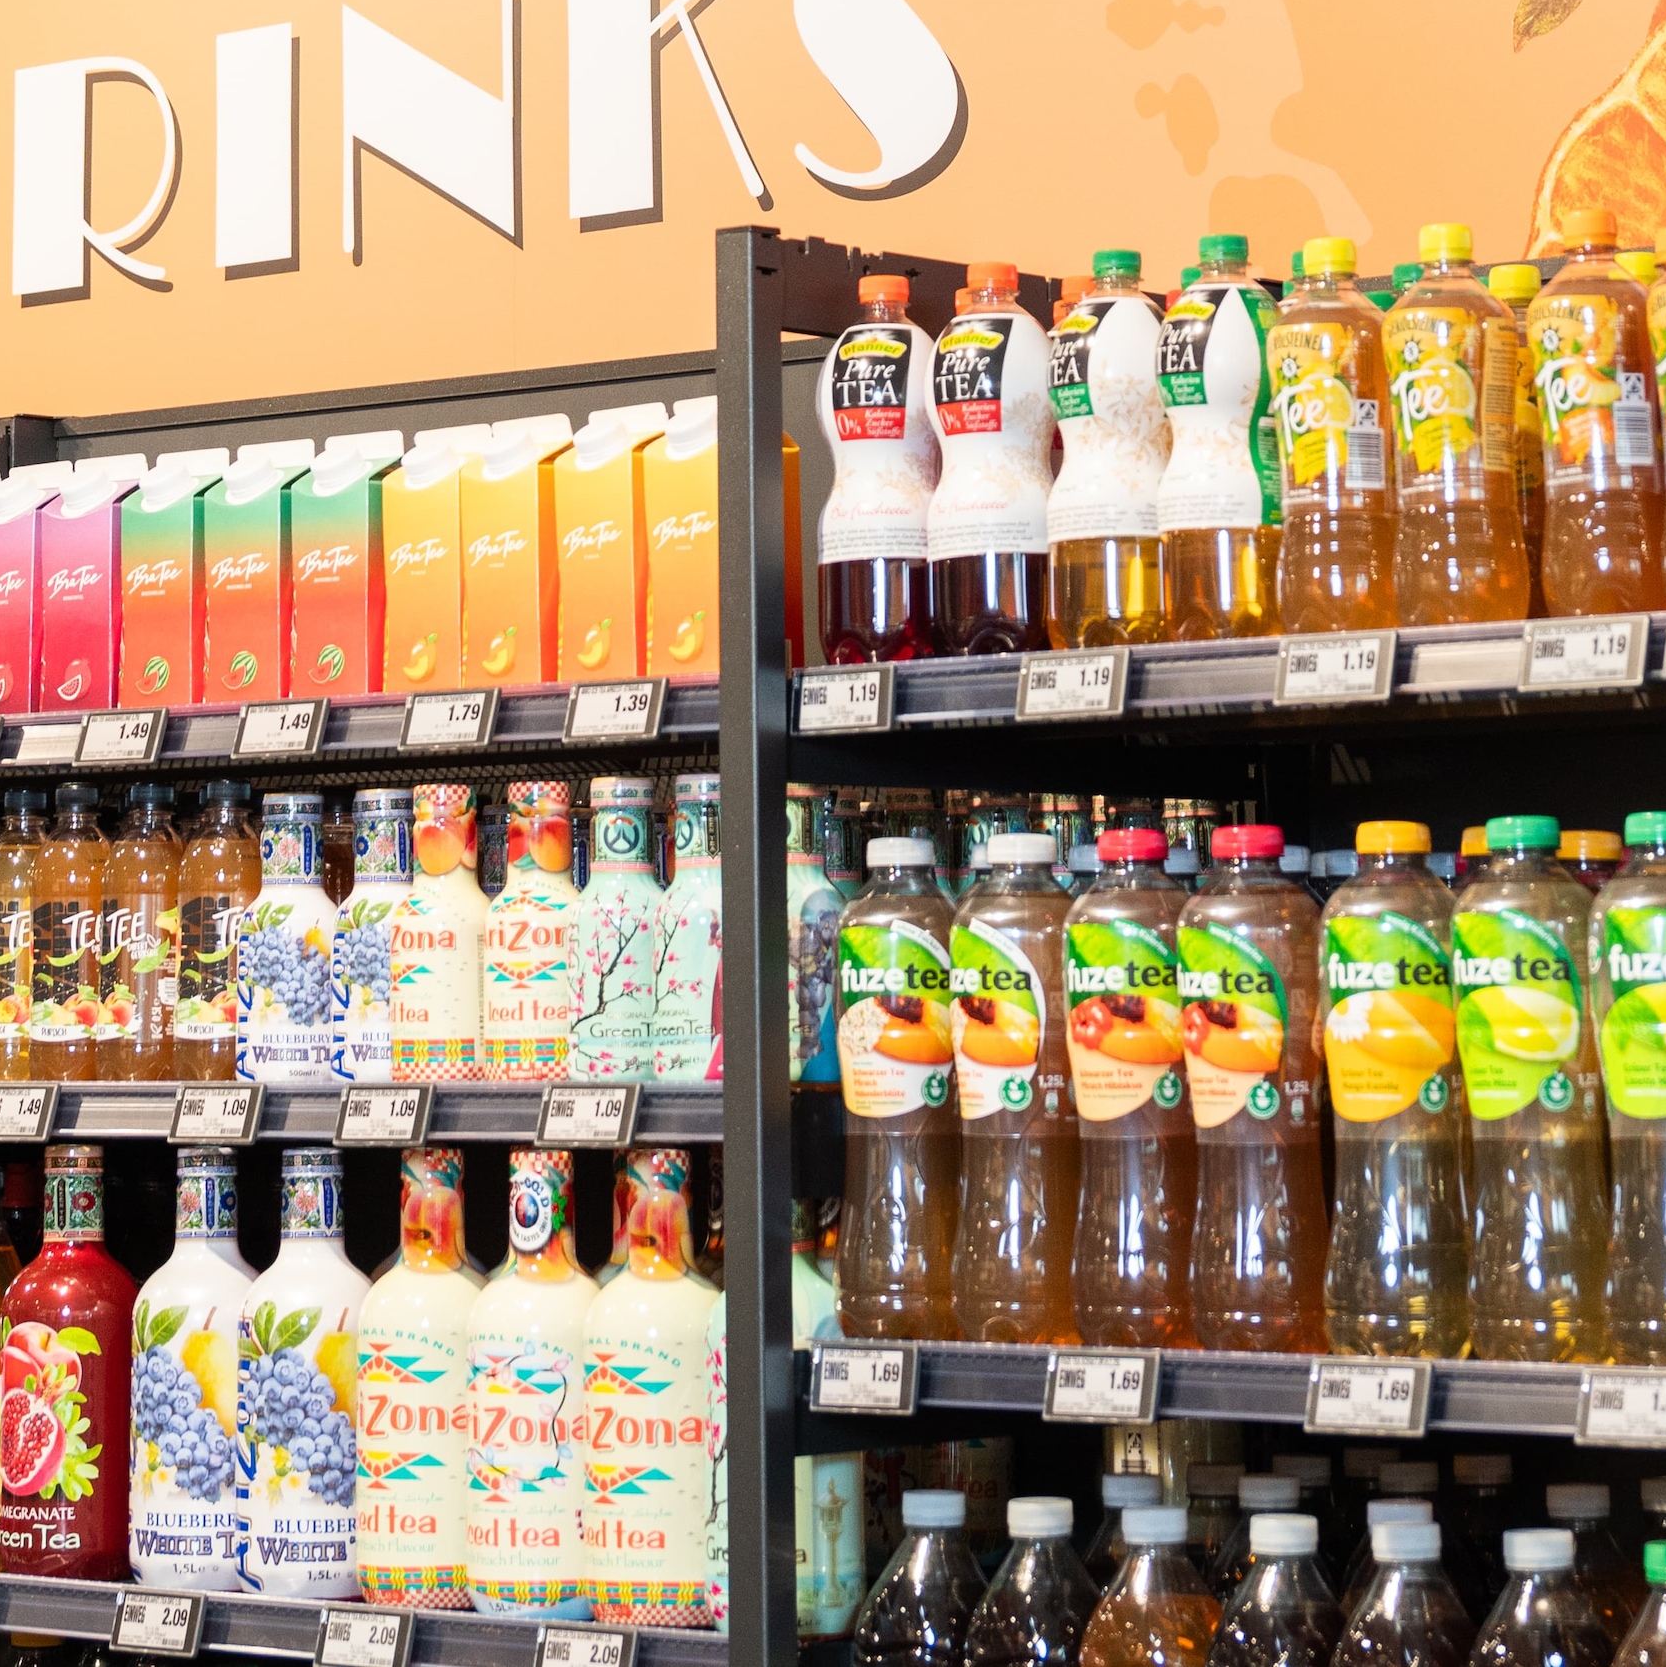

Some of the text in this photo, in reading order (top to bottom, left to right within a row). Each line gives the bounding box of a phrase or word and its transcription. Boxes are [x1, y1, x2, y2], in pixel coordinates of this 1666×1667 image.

[844, 359, 896, 382] Pure
[940, 353, 991, 374] Pure
[837, 380, 899, 408] TEA
[936, 373, 993, 402] TEA
[1535, 356, 1593, 433] Tee
[1391, 368, 1448, 441] Tee
[1274, 382, 1332, 454] Tee
[1591, 635, 1626, 656] 1.19
[1342, 649, 1376, 671] 1.19
[1079, 666, 1110, 688] 1.19
[614, 693, 648, 713] 1.39
[848, 681, 877, 703] 1.19
[279, 713, 311, 730] 1.49
[448, 703, 481, 722] 1.79
[118, 722, 150, 740] 1.49
[106, 907, 146, 954] TEE
[1328, 952, 1452, 989] fuzetea
[488, 1000, 568, 1022] Iced tea
[262, 1033, 330, 1043] BLUEBERRY
[590, 1022, 642, 1039] Green
[681, 1020, 716, 1036] Tea
[252, 1045, 309, 1062] WHITE
[19, 1098, 41, 1116] 1.49
[221, 1098, 247, 1117] 1.09
[389, 1100, 416, 1117] 1.09
[594, 1100, 621, 1117] 1.09
[395, 1329, 456, 1358] BRAND
[620, 1339, 681, 1368] BRAND
[869, 1360, 901, 1384] 1.69
[1108, 1368, 1141, 1391] 1.69
[1375, 1378, 1410, 1402] 1.69
[388, 1504, 438, 1534] tea
[32, 1523, 81, 1550] Tea
[135, 1530, 213, 1556] WHITE
[507, 1517, 561, 1548] tea
[614, 1519, 666, 1550] tea
[257, 1536, 347, 1565] WHITE
[161, 1608, 188, 1628] 2.09
[368, 1625, 396, 1645] 2.09
[545, 1642, 619, 1665] EINWEG 2.09
